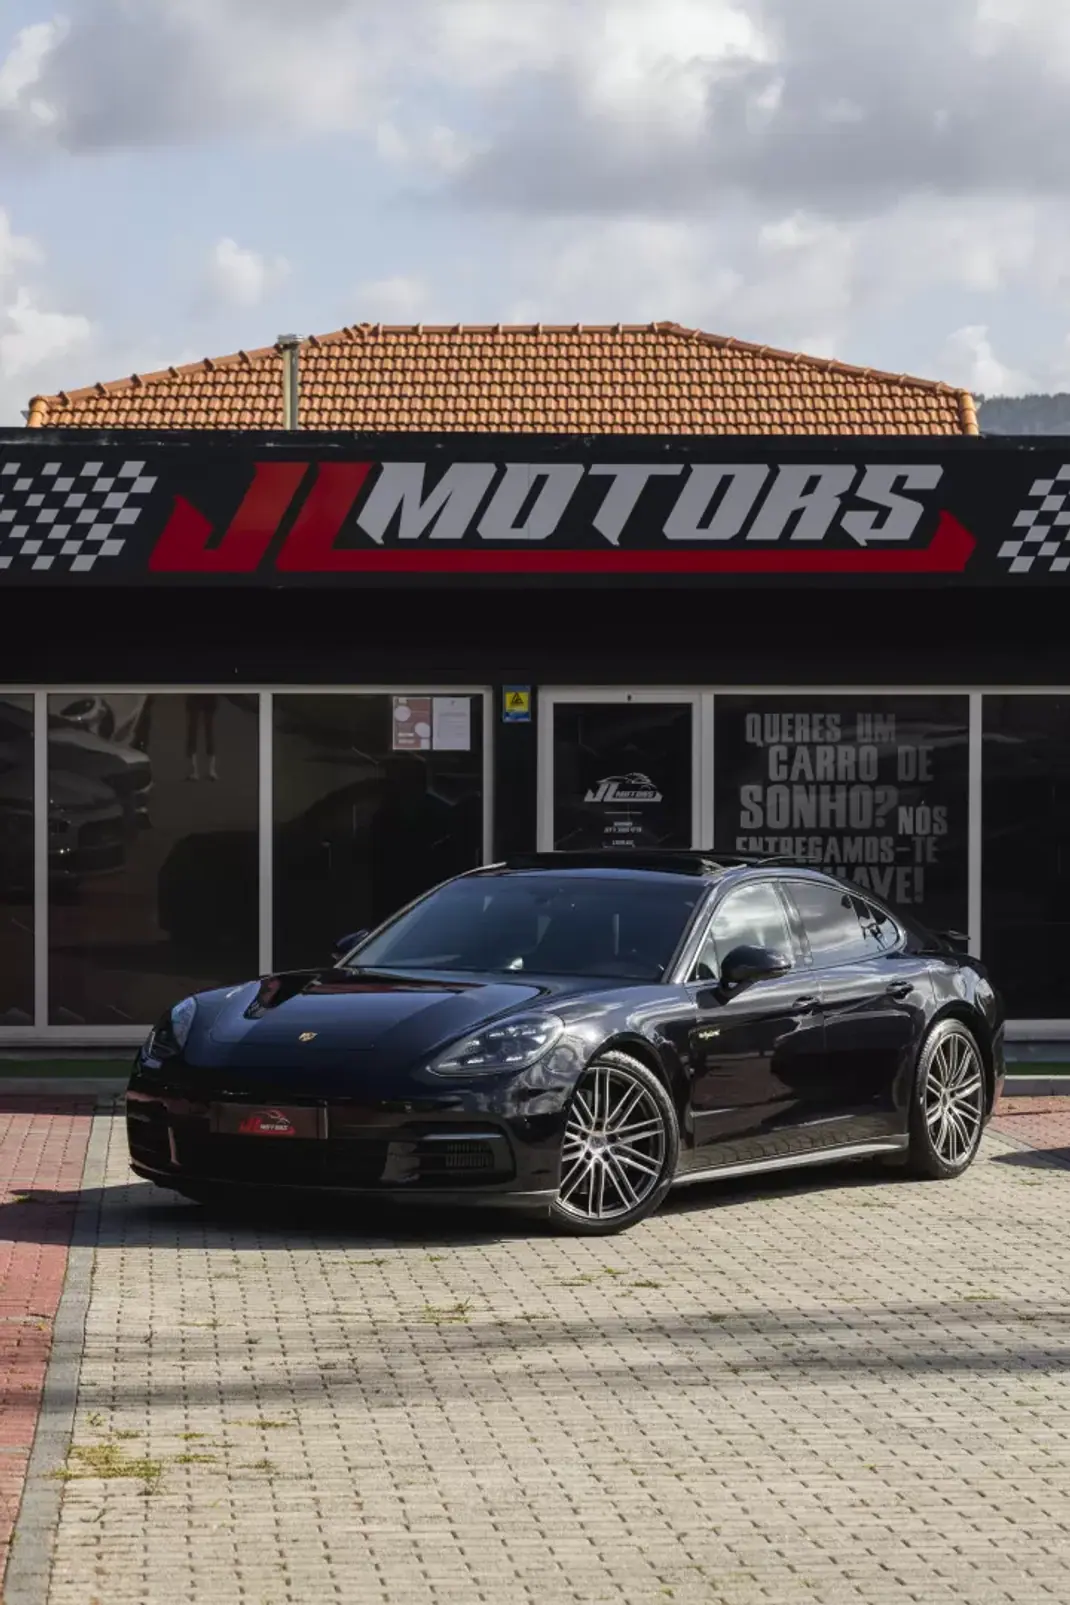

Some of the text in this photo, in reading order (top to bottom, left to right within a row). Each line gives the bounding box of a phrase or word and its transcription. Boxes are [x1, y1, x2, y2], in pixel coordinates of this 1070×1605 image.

[357, 463, 943, 546] MOTORS
[745, 712, 896, 747] QUERES UM
[768, 745, 934, 782] CARRO DE
[740, 784, 948, 835] SONHO? NÓS
